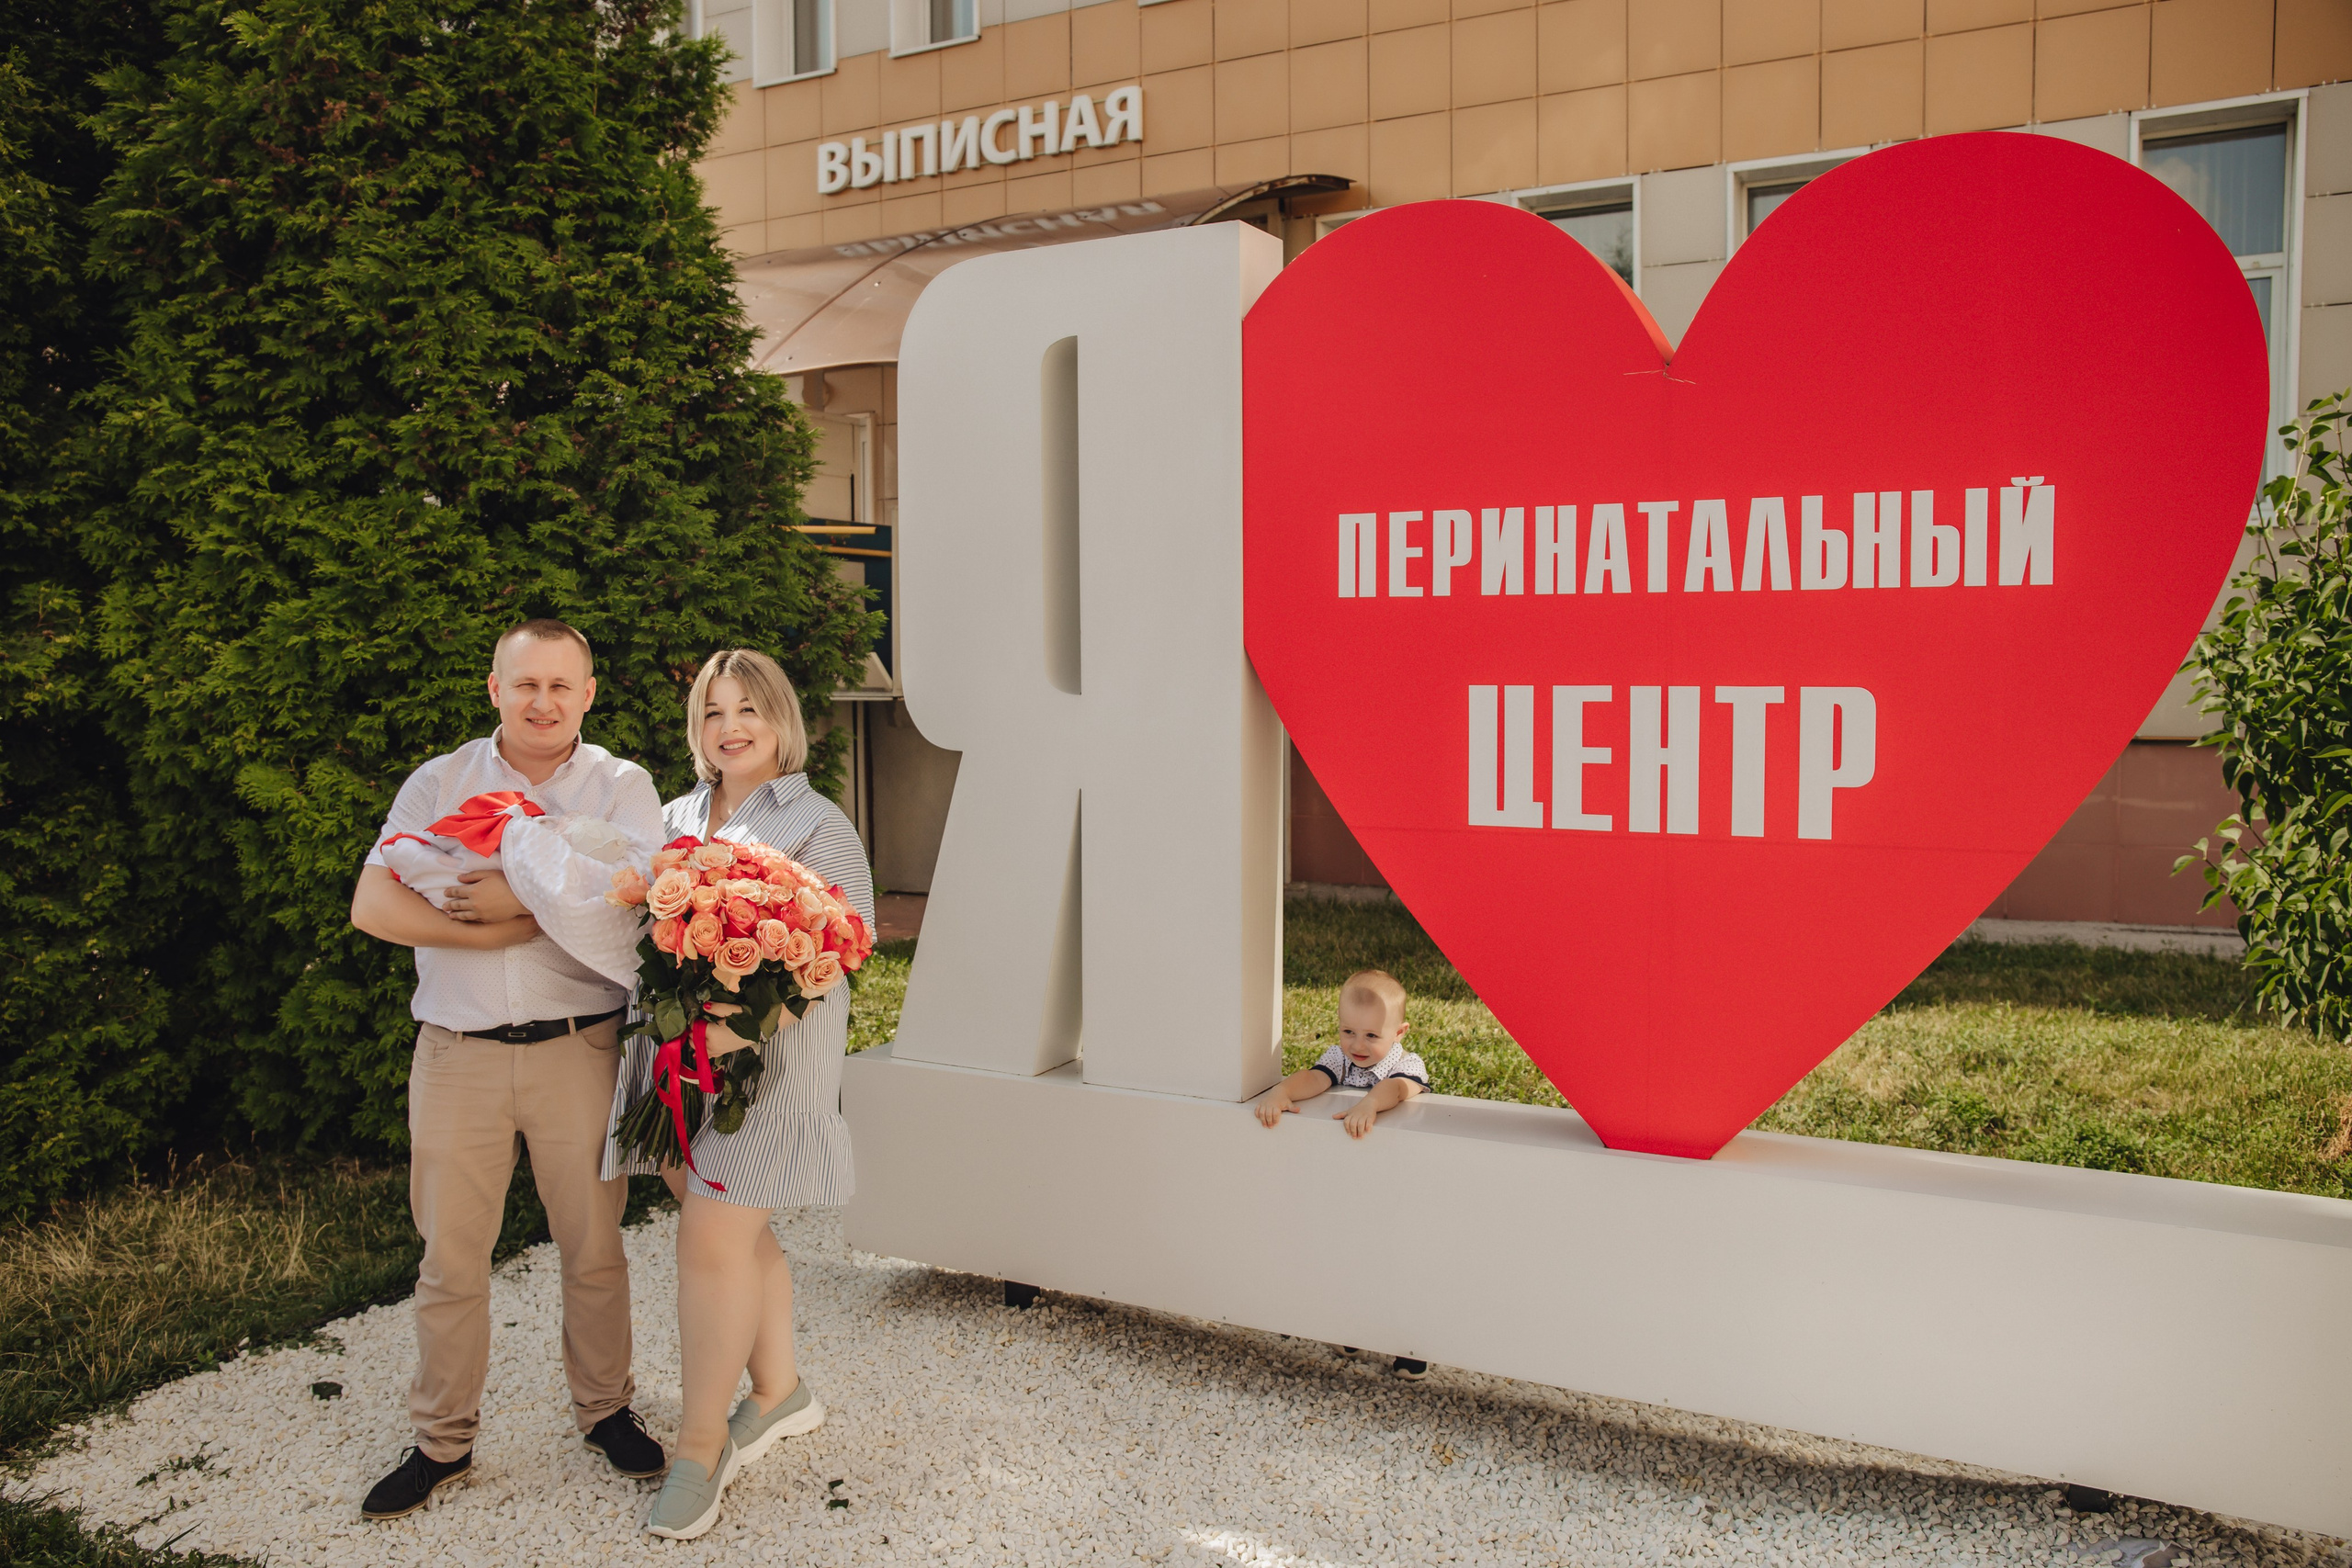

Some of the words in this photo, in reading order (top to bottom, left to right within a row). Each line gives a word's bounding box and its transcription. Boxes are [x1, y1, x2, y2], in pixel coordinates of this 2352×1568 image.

[817, 85, 1143, 195] ВЫПИСНАЯ
[1338, 475, 2055, 598] ПЕРИНАТАЛЬНЫЙ
[891, 220, 1283, 1102] Я
[1467, 684, 1877, 840] ЦЕНТР
